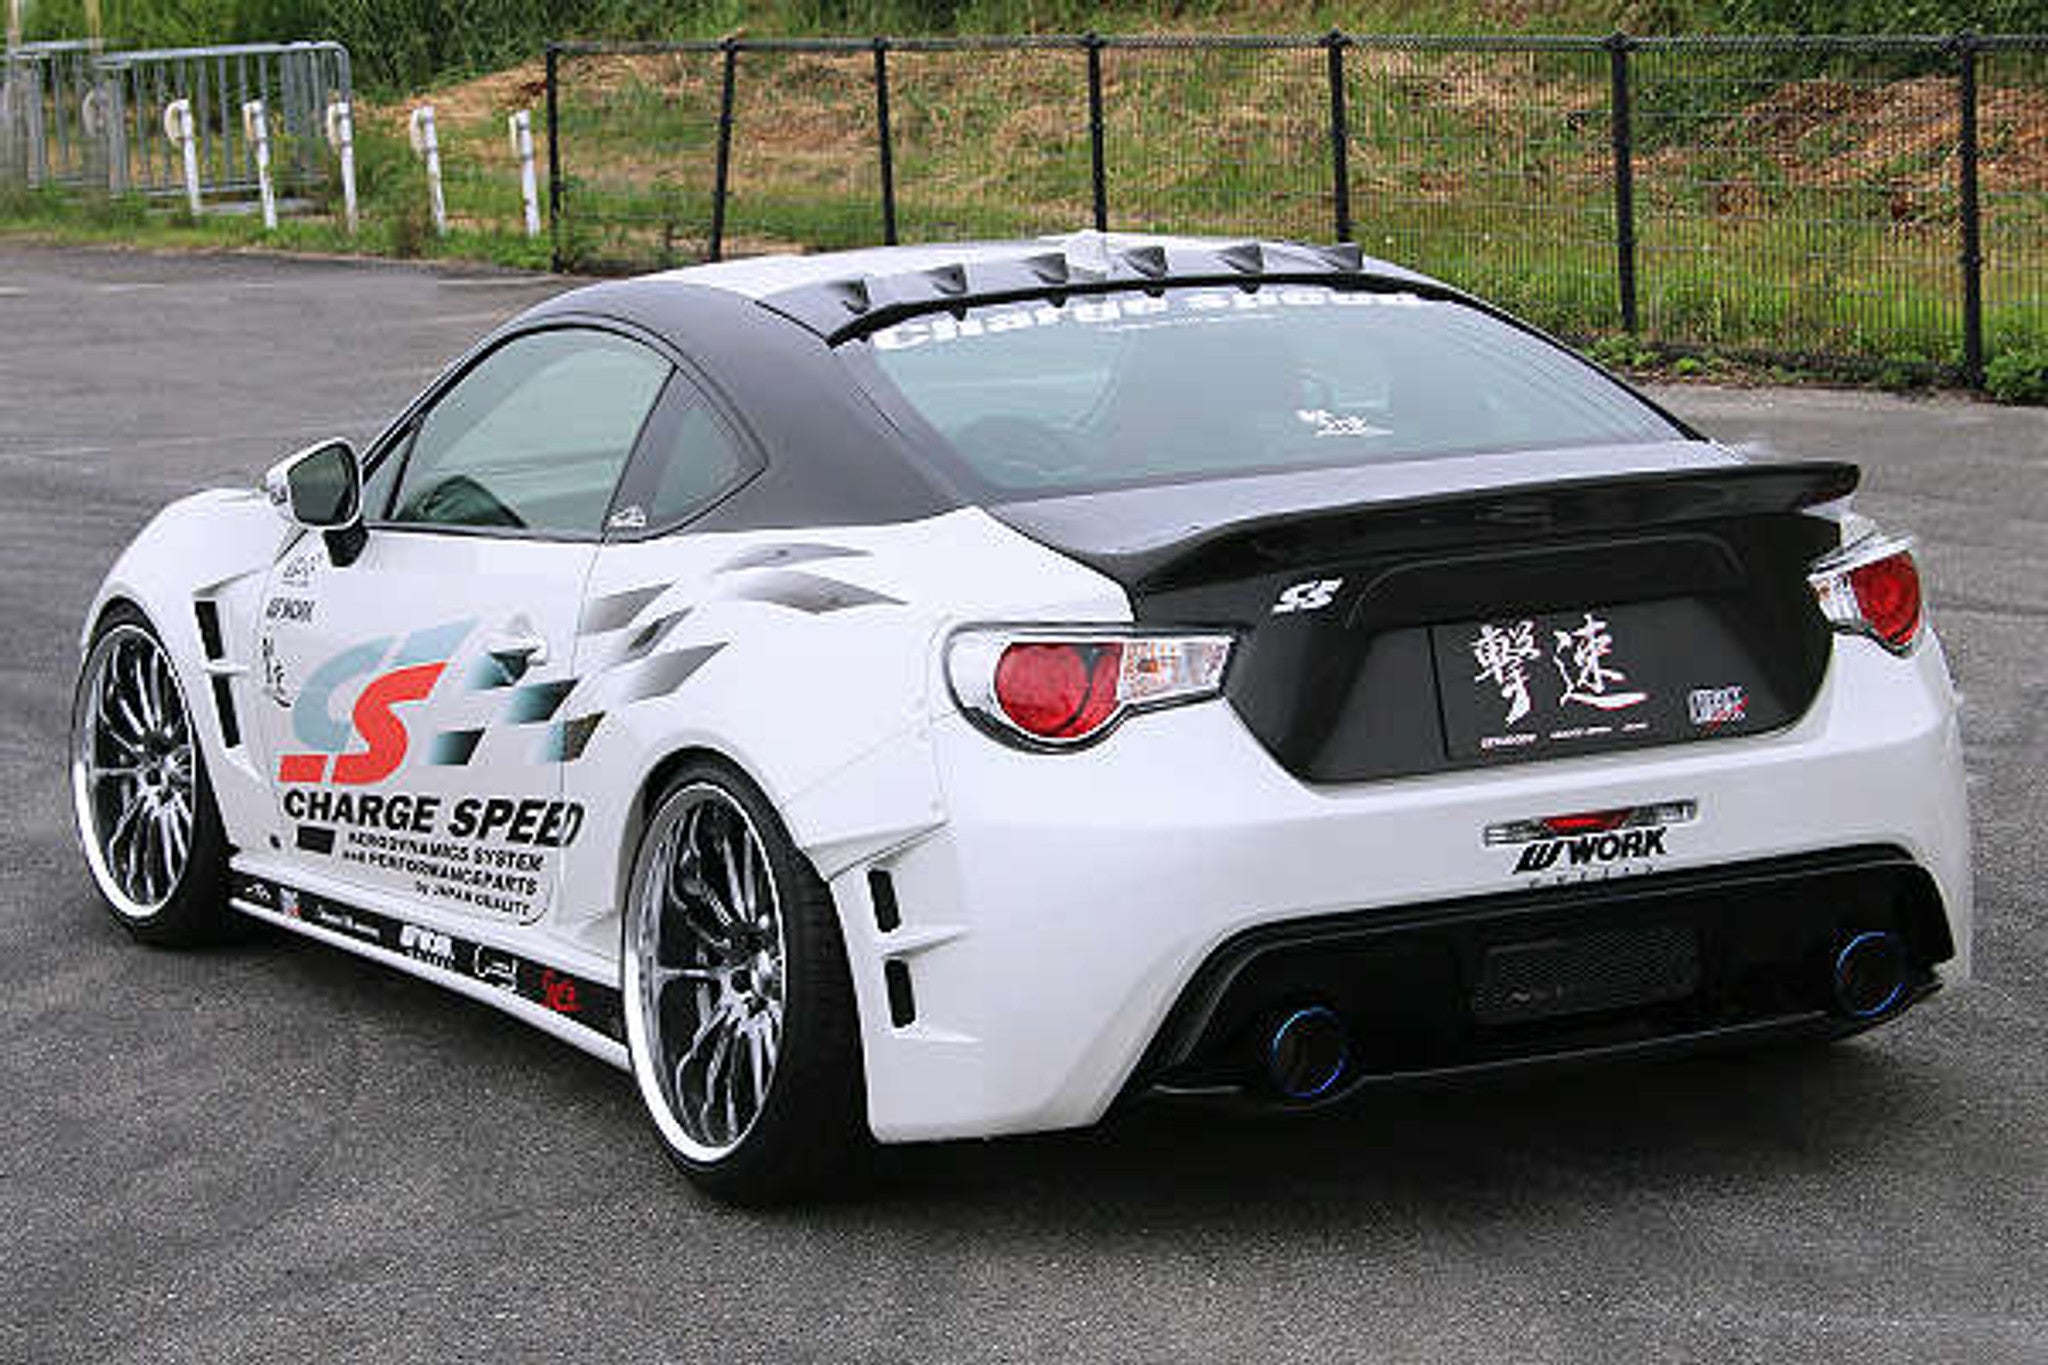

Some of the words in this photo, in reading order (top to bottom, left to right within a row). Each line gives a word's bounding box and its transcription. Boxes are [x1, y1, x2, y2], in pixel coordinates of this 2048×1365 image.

[1471, 613, 1647, 728] 撃速
[284, 789, 441, 834] CHARGE
[448, 799, 586, 848] SPEED
[474, 847, 544, 872] SYSTEM
[1568, 826, 1667, 865] WORK
[483, 869, 538, 896] PARTS
